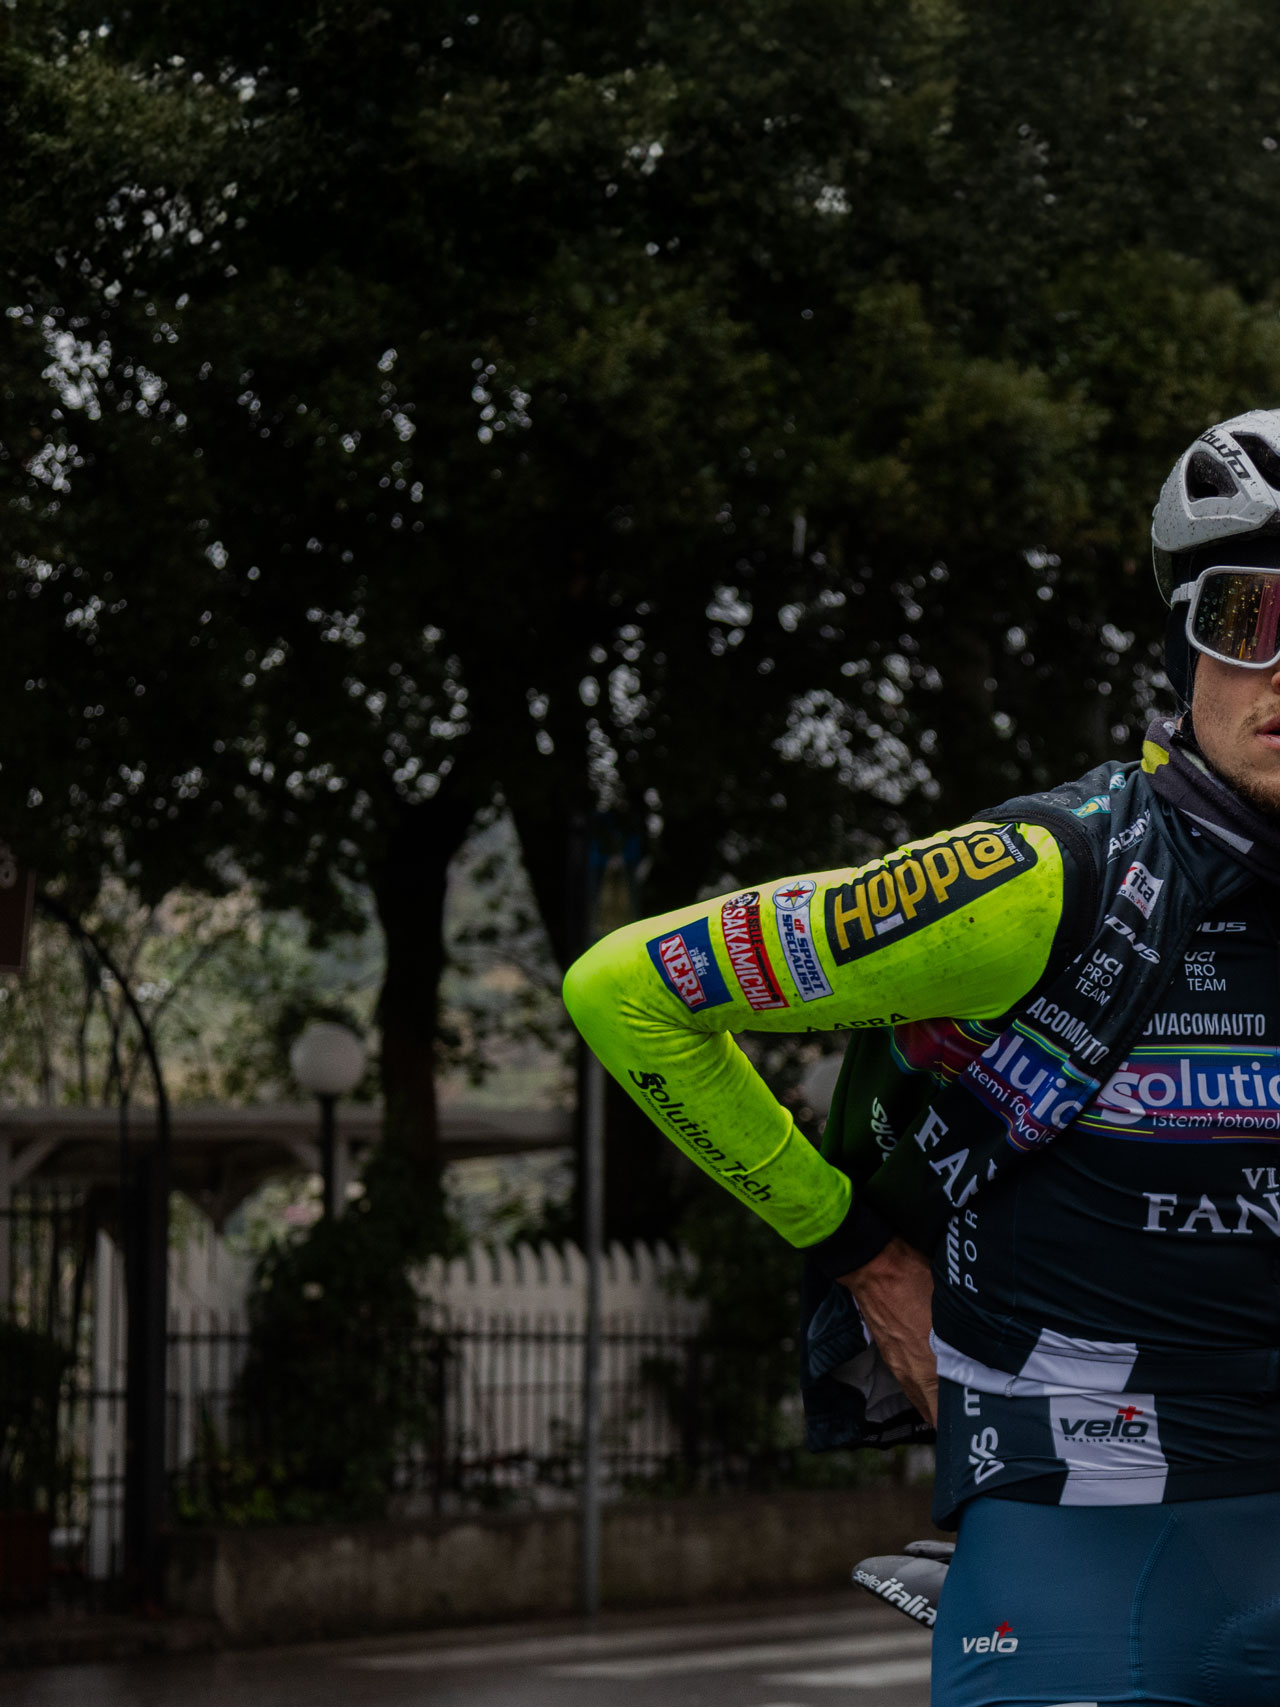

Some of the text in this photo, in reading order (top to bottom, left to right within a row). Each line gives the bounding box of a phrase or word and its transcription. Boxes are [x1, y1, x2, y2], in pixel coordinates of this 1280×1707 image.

[749, 922, 764, 946] SELLE
[797, 937, 826, 991] SPORT
[1093, 949, 1124, 976] UCI
[1184, 951, 1216, 962] UCI
[661, 936, 704, 1007] NERI
[1082, 963, 1113, 987] PRO
[1184, 964, 1216, 977] PRO
[1075, 976, 1111, 1007] TEAM
[1187, 978, 1227, 991] TEAM
[1059, 1414, 1150, 1438] velo
[853, 1570, 938, 1626] selle italia
[962, 1631, 1019, 1654] velo
